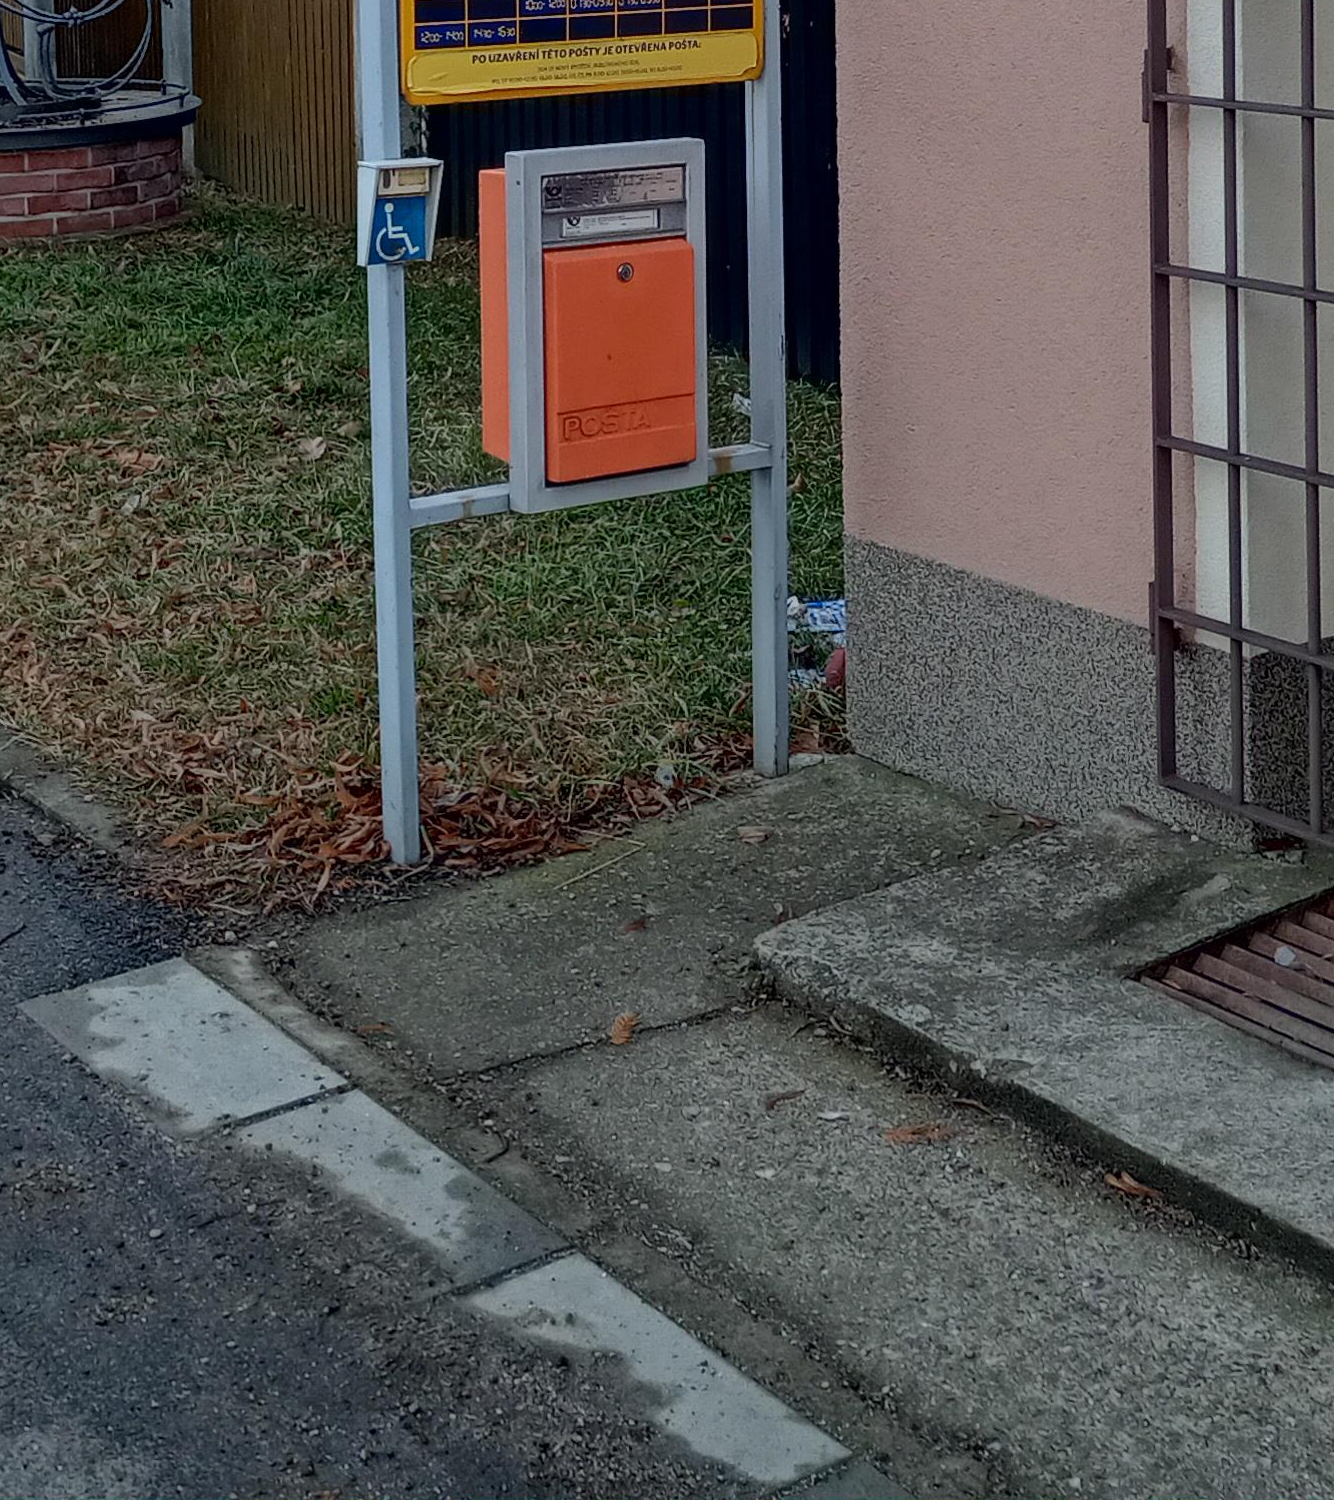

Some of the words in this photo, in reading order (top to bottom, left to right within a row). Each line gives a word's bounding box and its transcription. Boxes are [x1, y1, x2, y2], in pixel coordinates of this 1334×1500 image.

[472, 53, 487, 65] PO
[489, 47, 540, 63] UZAVŘENÍ
[542, 48, 568, 59] TÉTO
[568, 45, 601, 58] POŠTY
[602, 45, 614, 57] JE
[615, 41, 666, 55] OTEVŘENA
[563, 407, 651, 441] POŠTA
